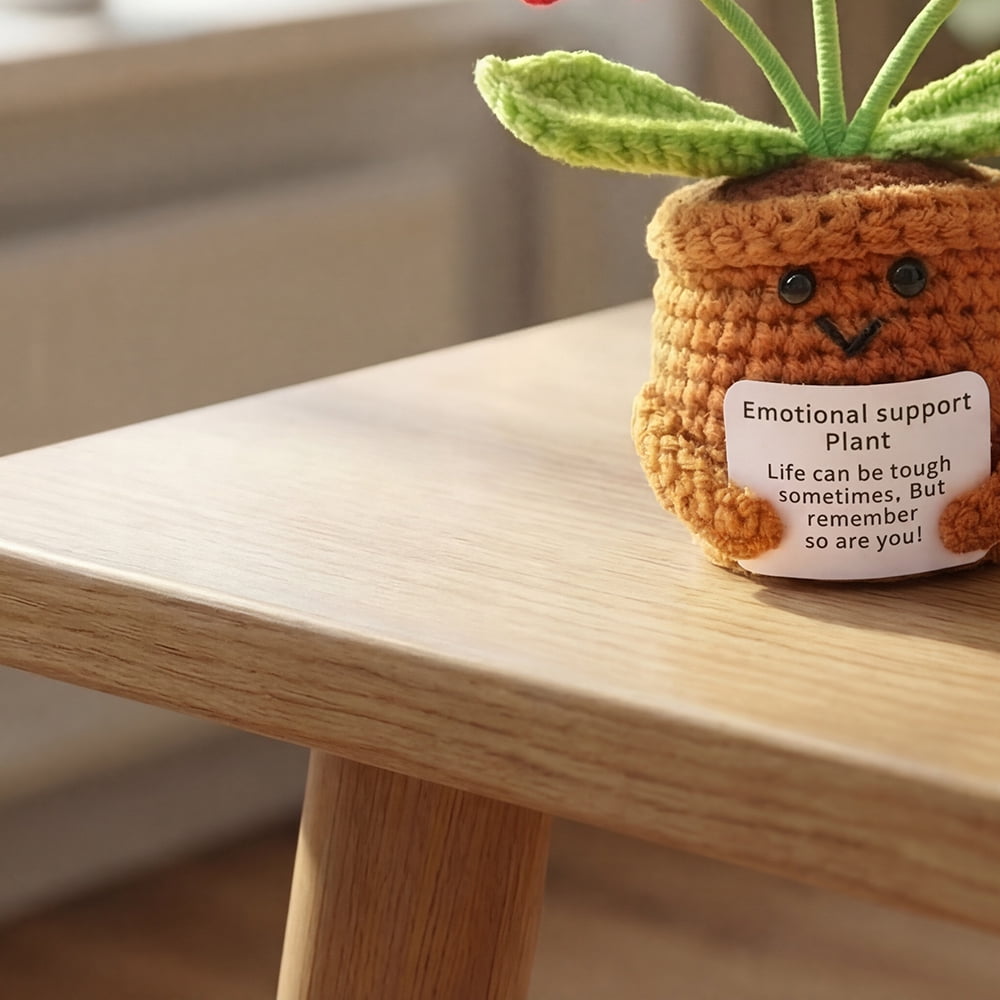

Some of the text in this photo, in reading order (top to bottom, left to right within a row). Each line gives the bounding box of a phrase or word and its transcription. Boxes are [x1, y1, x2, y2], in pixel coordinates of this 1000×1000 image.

[743, 392, 972, 426] Emotional support
[826, 431, 891, 452] Plant
[768, 454, 951, 482] Life can be tough
[779, 479, 946, 505] sometimes, But
[807, 506, 919, 527] remember
[805, 525, 922, 553] so are you!
